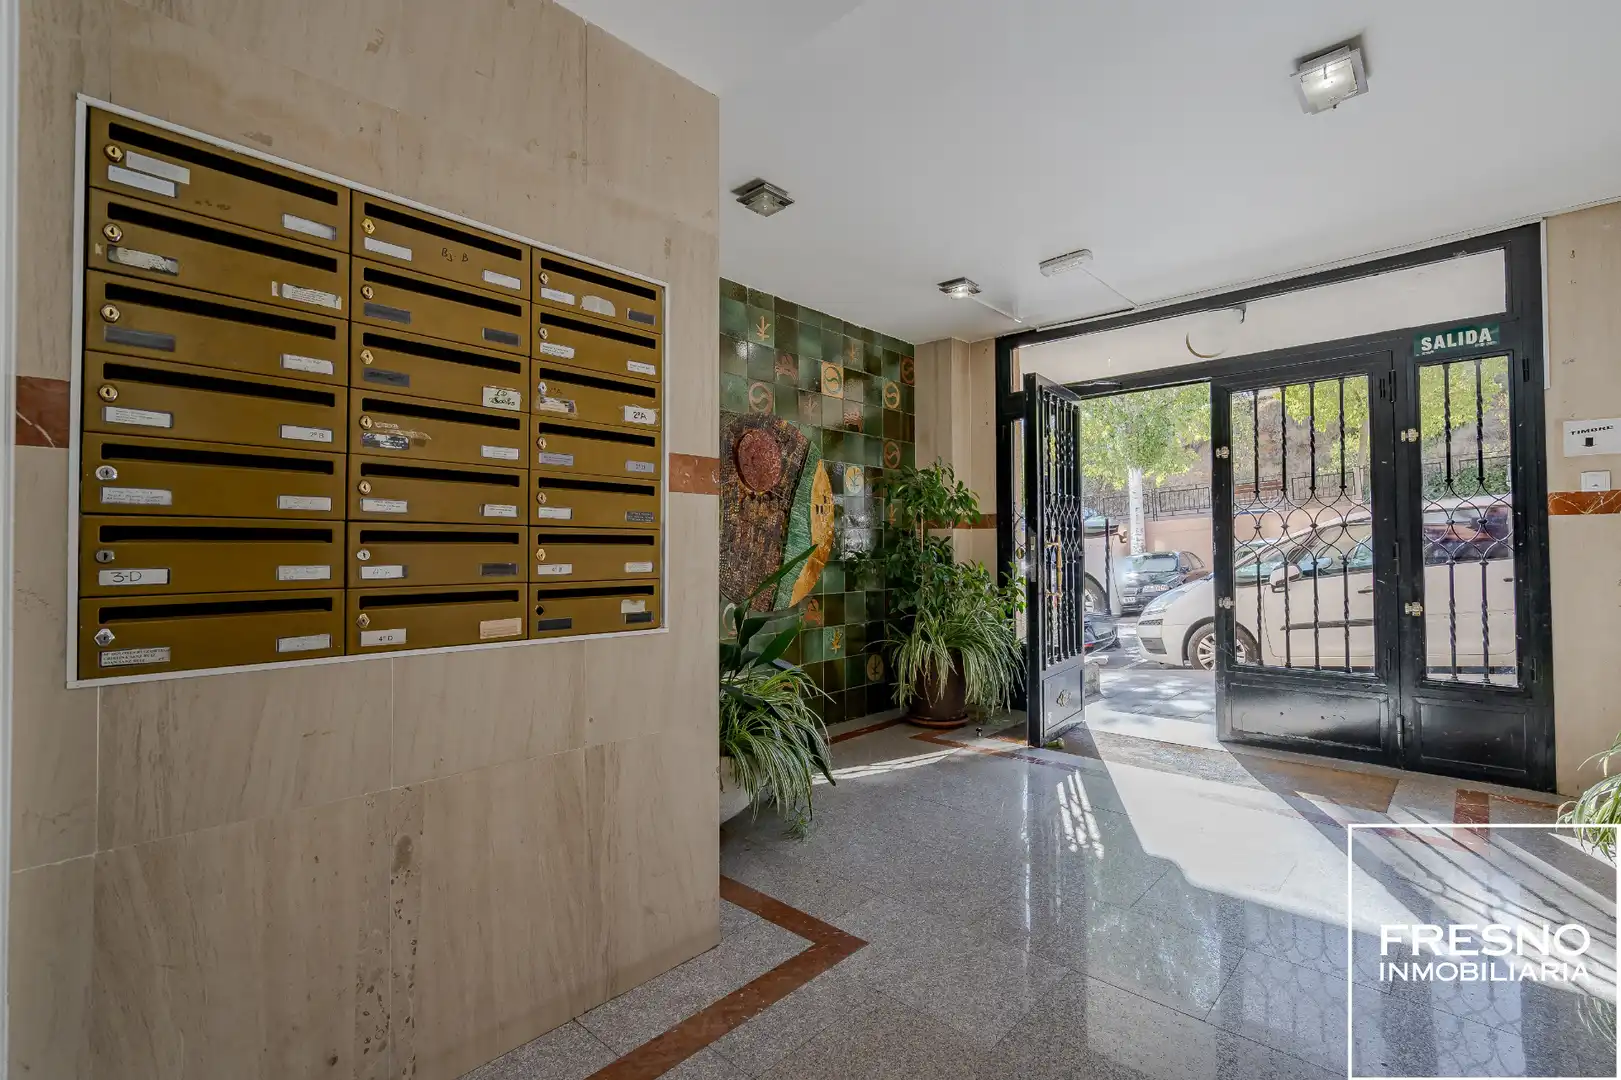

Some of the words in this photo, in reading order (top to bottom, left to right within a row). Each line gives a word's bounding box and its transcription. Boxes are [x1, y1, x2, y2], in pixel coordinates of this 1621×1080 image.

[1421, 327, 1492, 351] SALIDA
[1570, 425, 1614, 435] TIMBRE
[110, 571, 142, 583] 3-D
